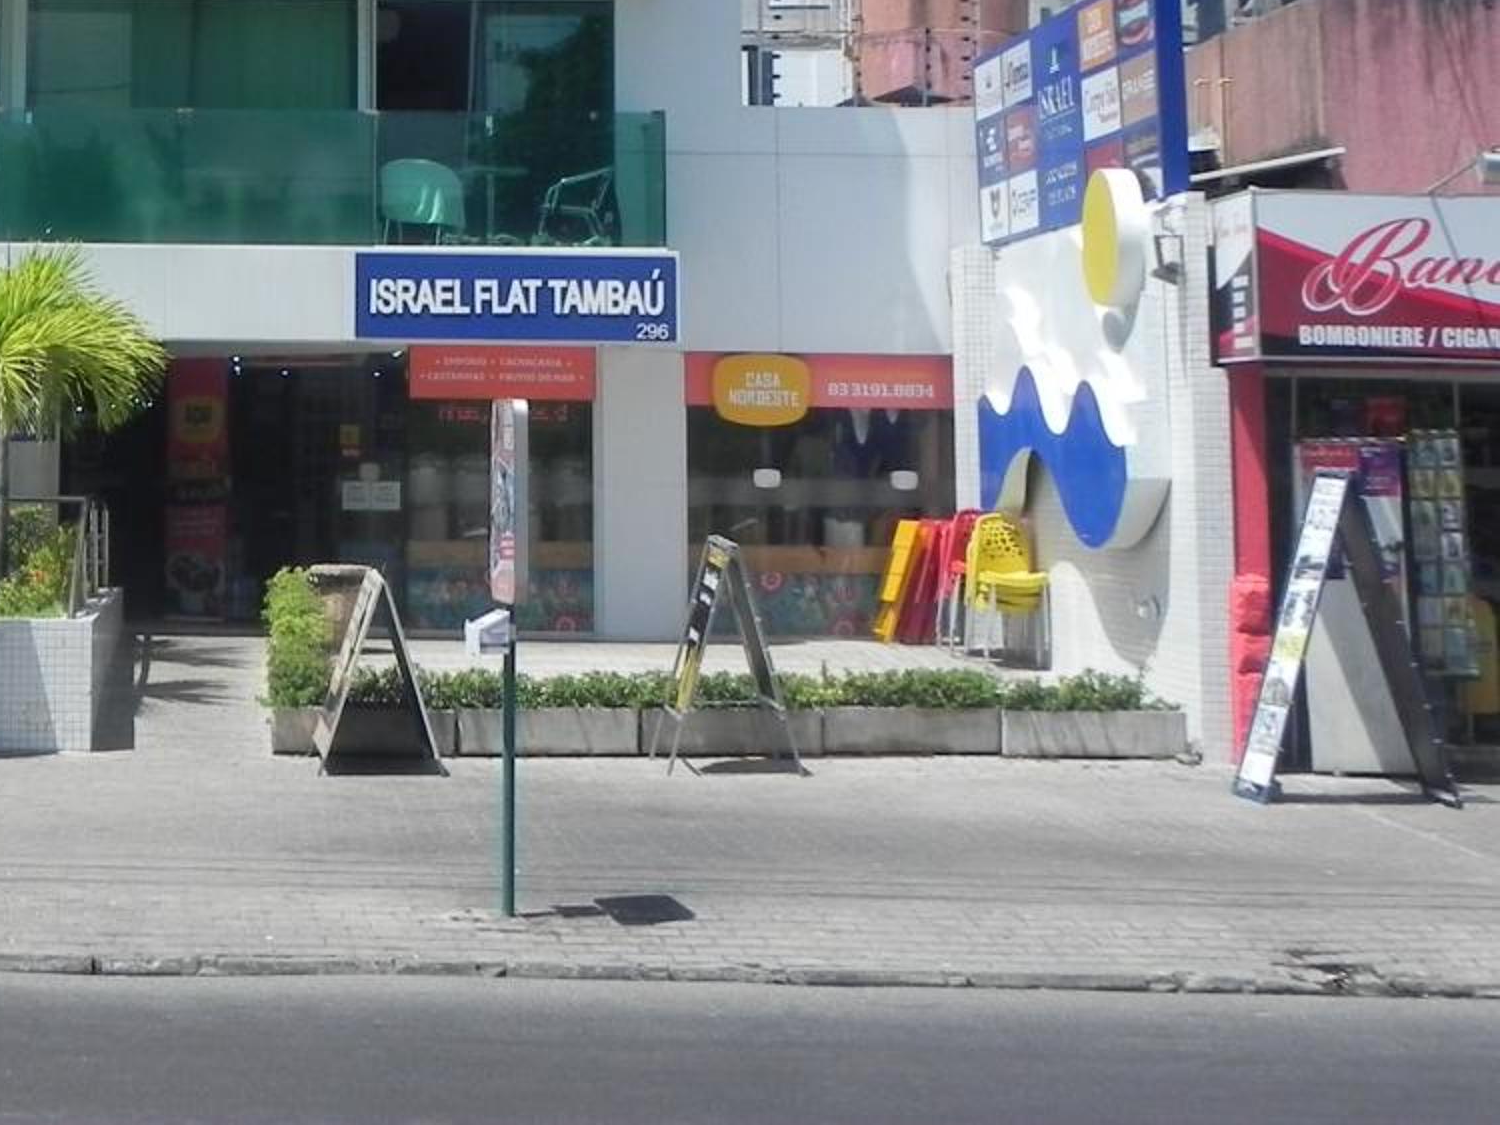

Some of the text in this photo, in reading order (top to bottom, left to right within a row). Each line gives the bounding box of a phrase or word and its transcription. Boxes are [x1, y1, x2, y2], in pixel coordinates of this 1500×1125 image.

[369, 268, 665, 316] ISRAEL FLAT TAMBAÚ
[636, 323, 669, 340] 296
[1299, 324, 1424, 348] BOMBONIERE
[745, 372, 781, 388] CASA
[729, 388, 800, 408] NORDESTE
